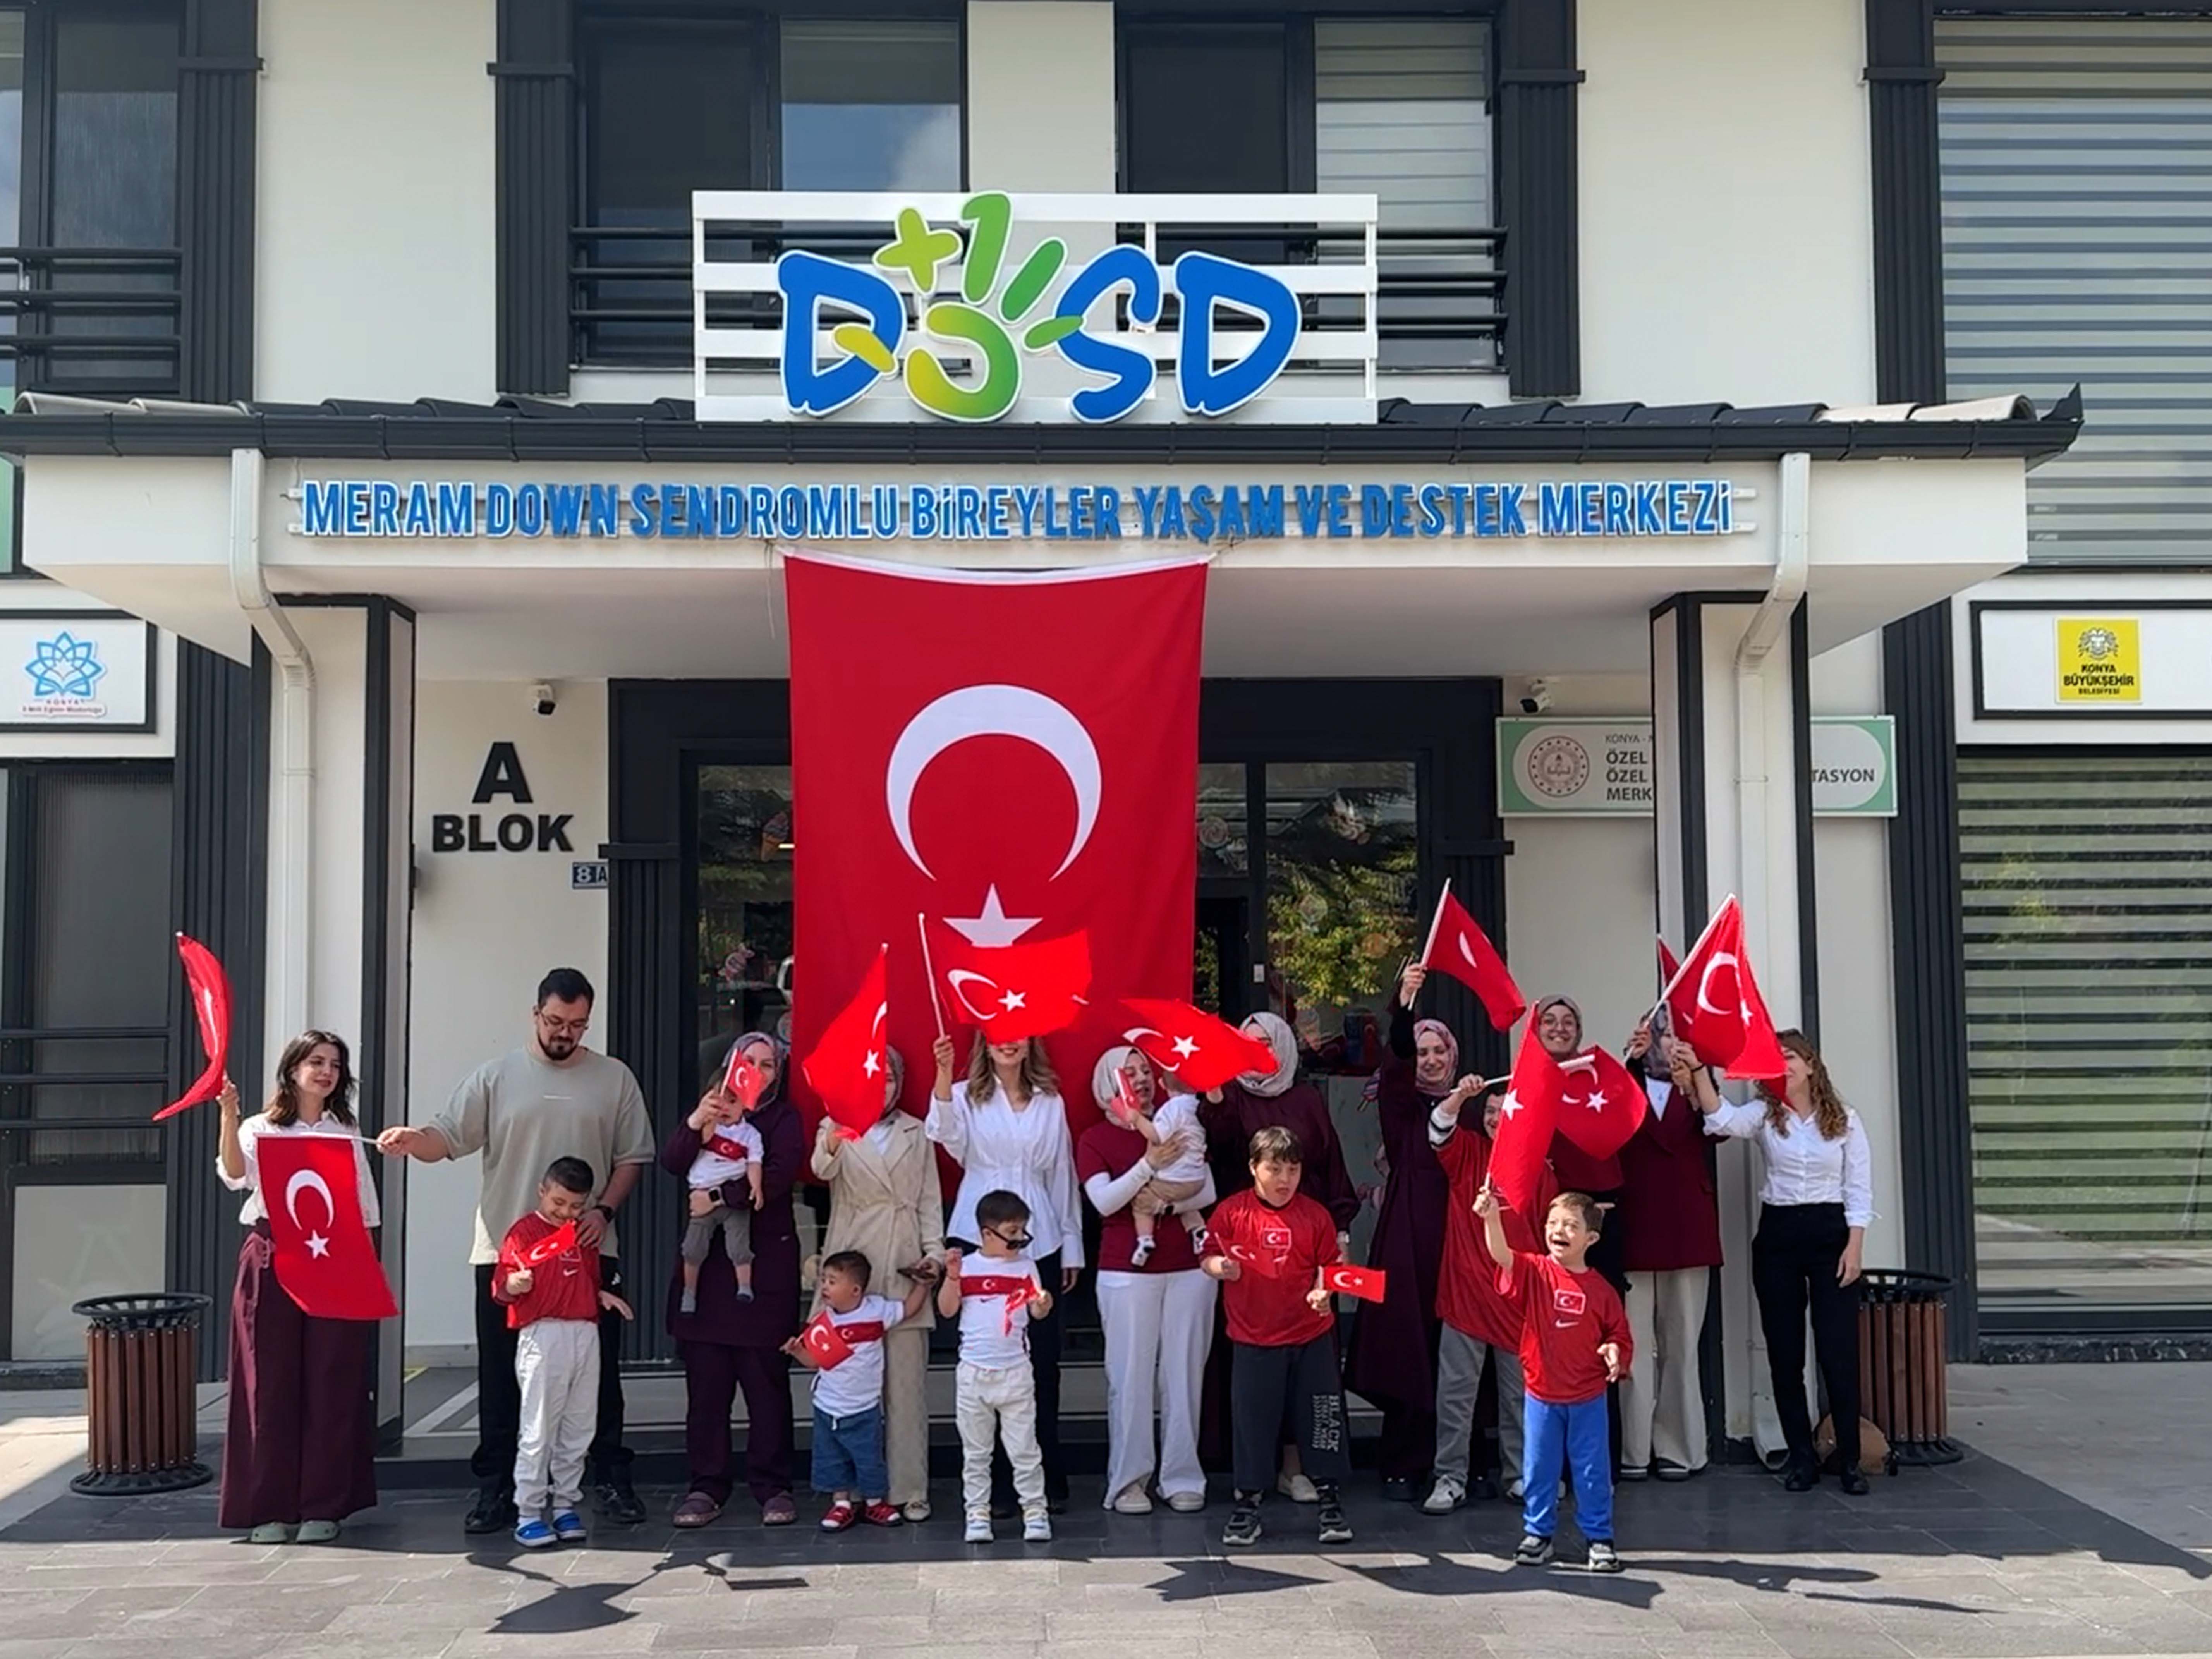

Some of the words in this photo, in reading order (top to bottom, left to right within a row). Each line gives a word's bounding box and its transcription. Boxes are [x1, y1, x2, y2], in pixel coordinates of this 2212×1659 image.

[303, 481, 476, 537] MERAM
[486, 483, 619, 538] DOWN
[630, 483, 902, 539] SENDROMLU
[1133, 484, 1285, 545] YAŞAM
[1295, 484, 1352, 538] VE
[1361, 483, 1528, 538] DESTEK
[2081, 664, 2116, 673] KONYA
[1605, 733, 1640, 743] KONYA
[1606, 748, 1647, 764] ÖZEL
[472, 742, 534, 804] A
[1606, 767, 1647, 783] ÖZEL
[432, 814, 574, 852] BLOK
[576, 866, 591, 882] 8
